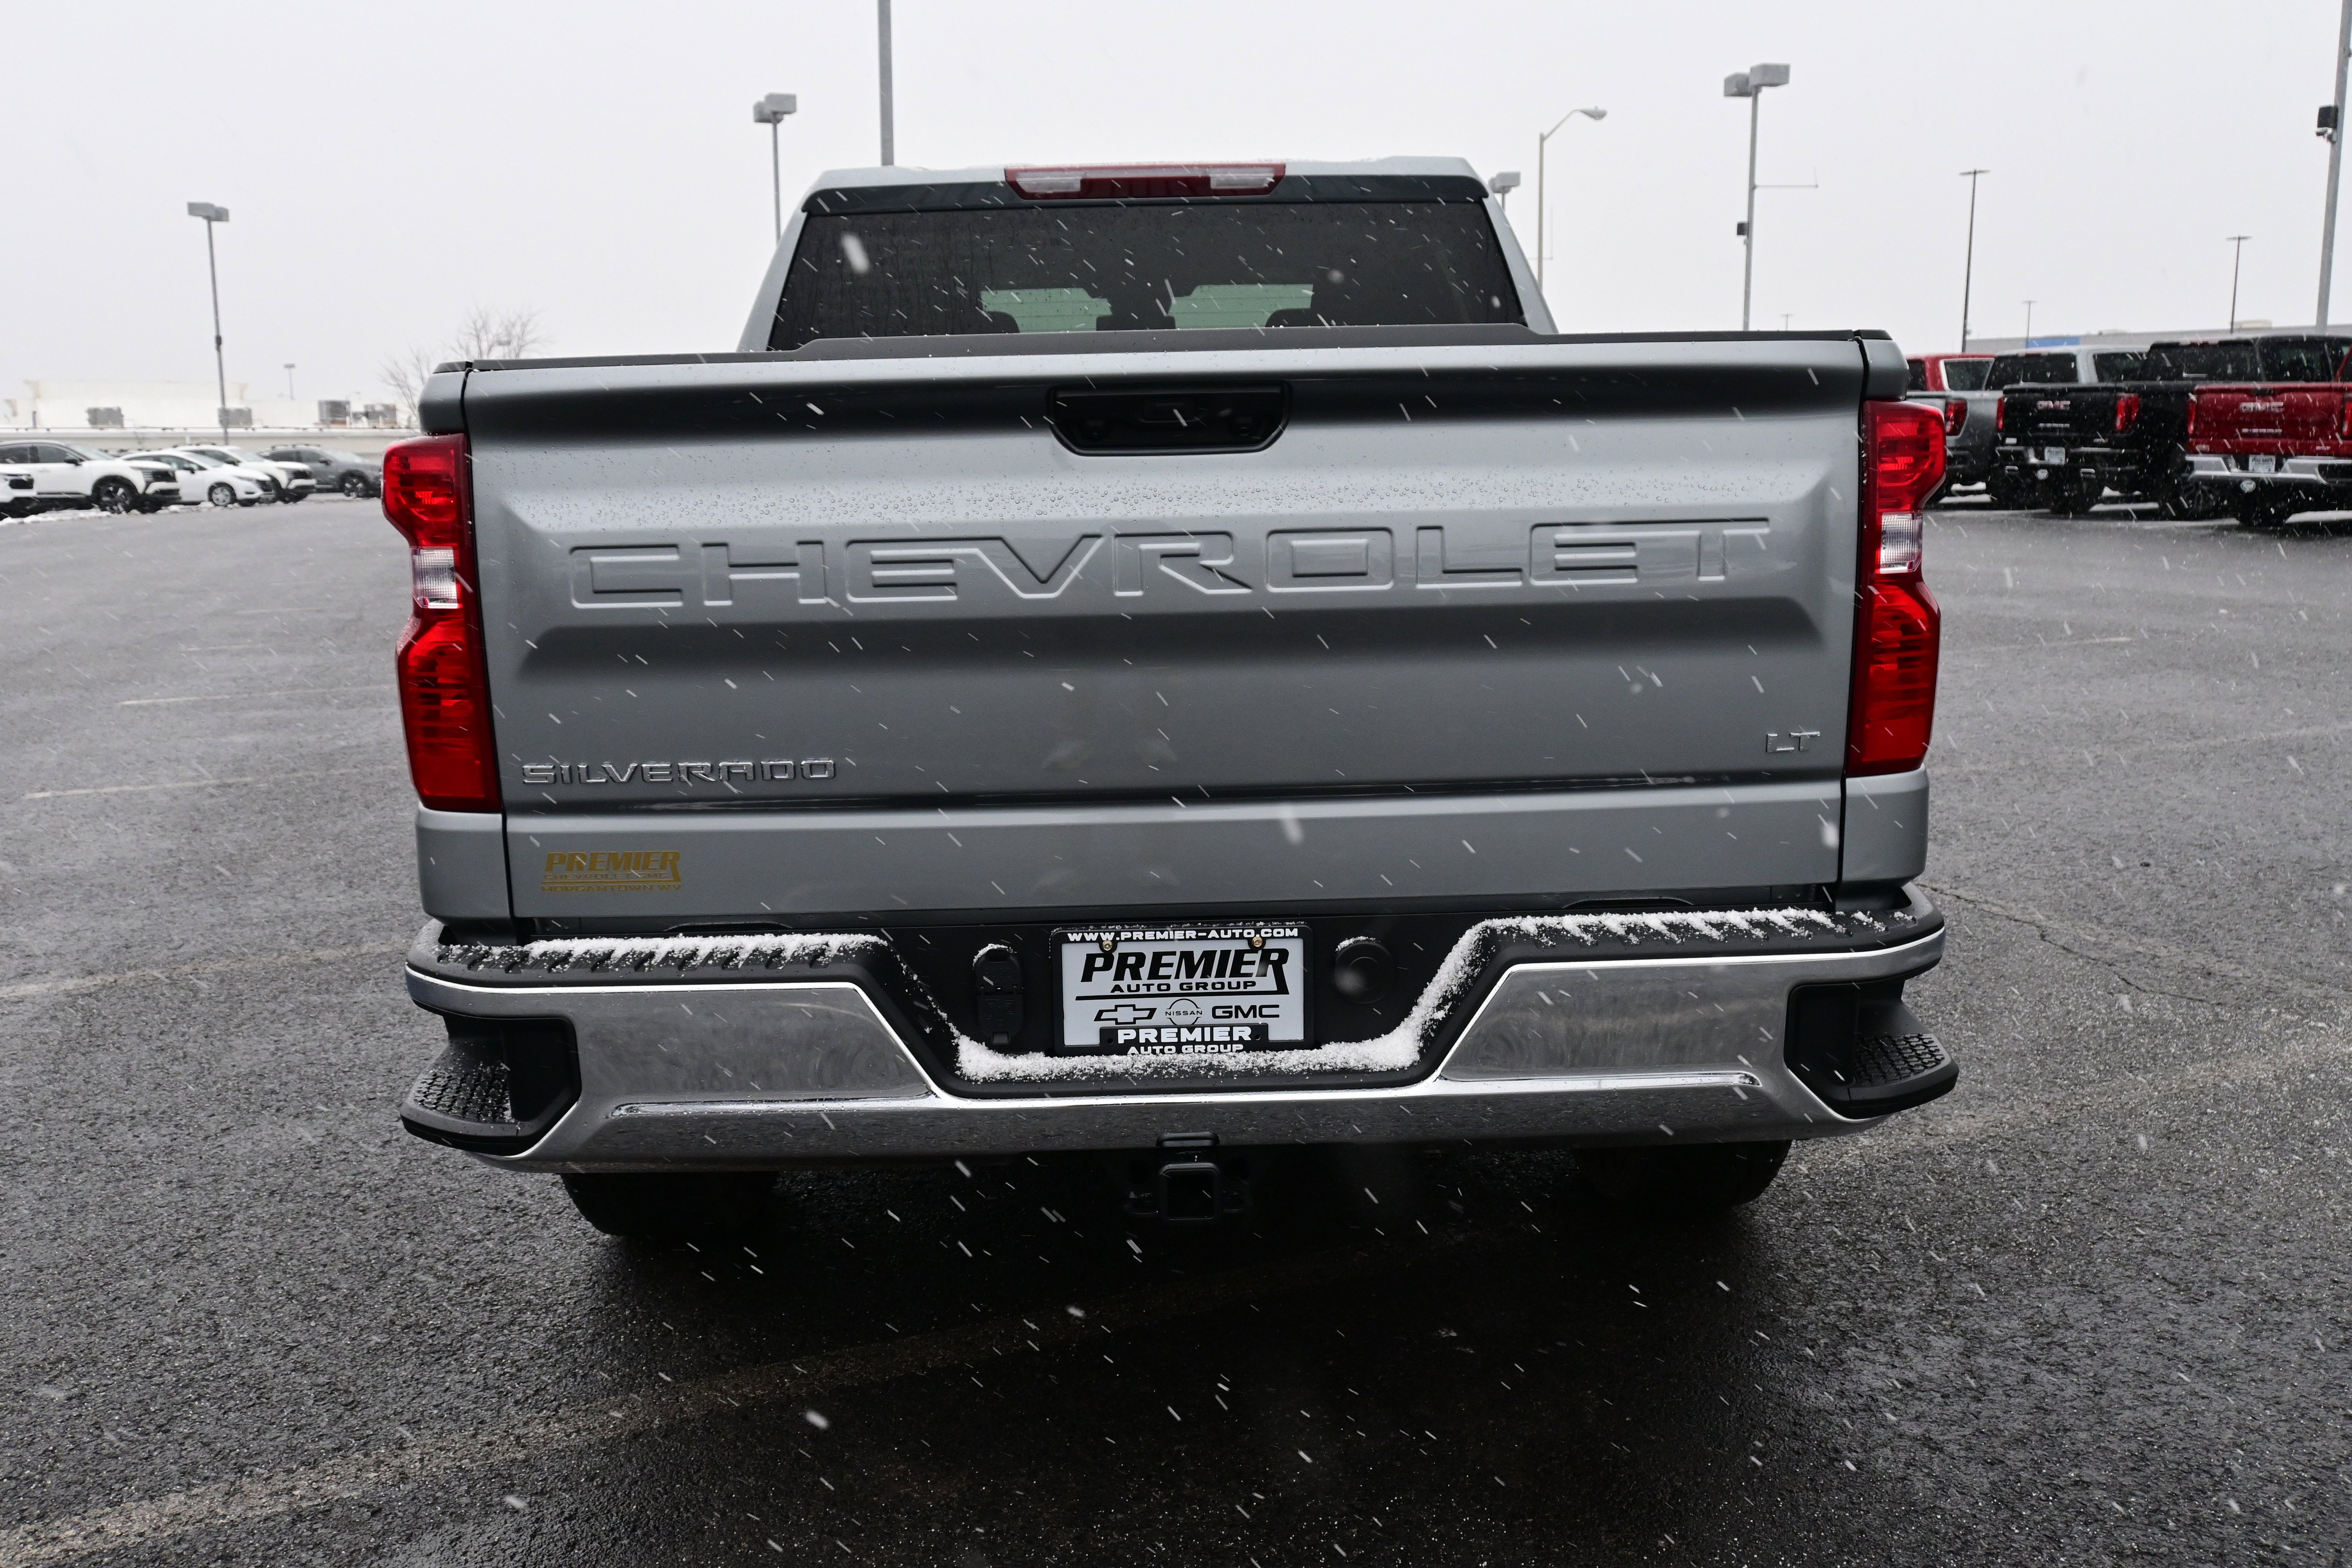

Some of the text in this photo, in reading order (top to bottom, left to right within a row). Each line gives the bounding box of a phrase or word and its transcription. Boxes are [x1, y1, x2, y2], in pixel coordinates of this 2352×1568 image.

[2240, 402, 2284, 413] GMC
[569, 517, 1770, 608] CHEVROLET
[1766, 731, 1820, 753] LT
[522, 759, 836, 784] SILVERADO
[545, 850, 682, 882] PREMIER
[1067, 928, 1298, 942] WWW.PREMIER-AUTO.COM
[1081, 948, 1290, 995] PREMIER
[1110, 981, 1256, 993] AUTO GROUP
[1212, 1004, 1280, 1019] GMC
[1118, 1026, 1252, 1044] PREMIER
[1127, 1044, 1244, 1055] AUTO GROUP
